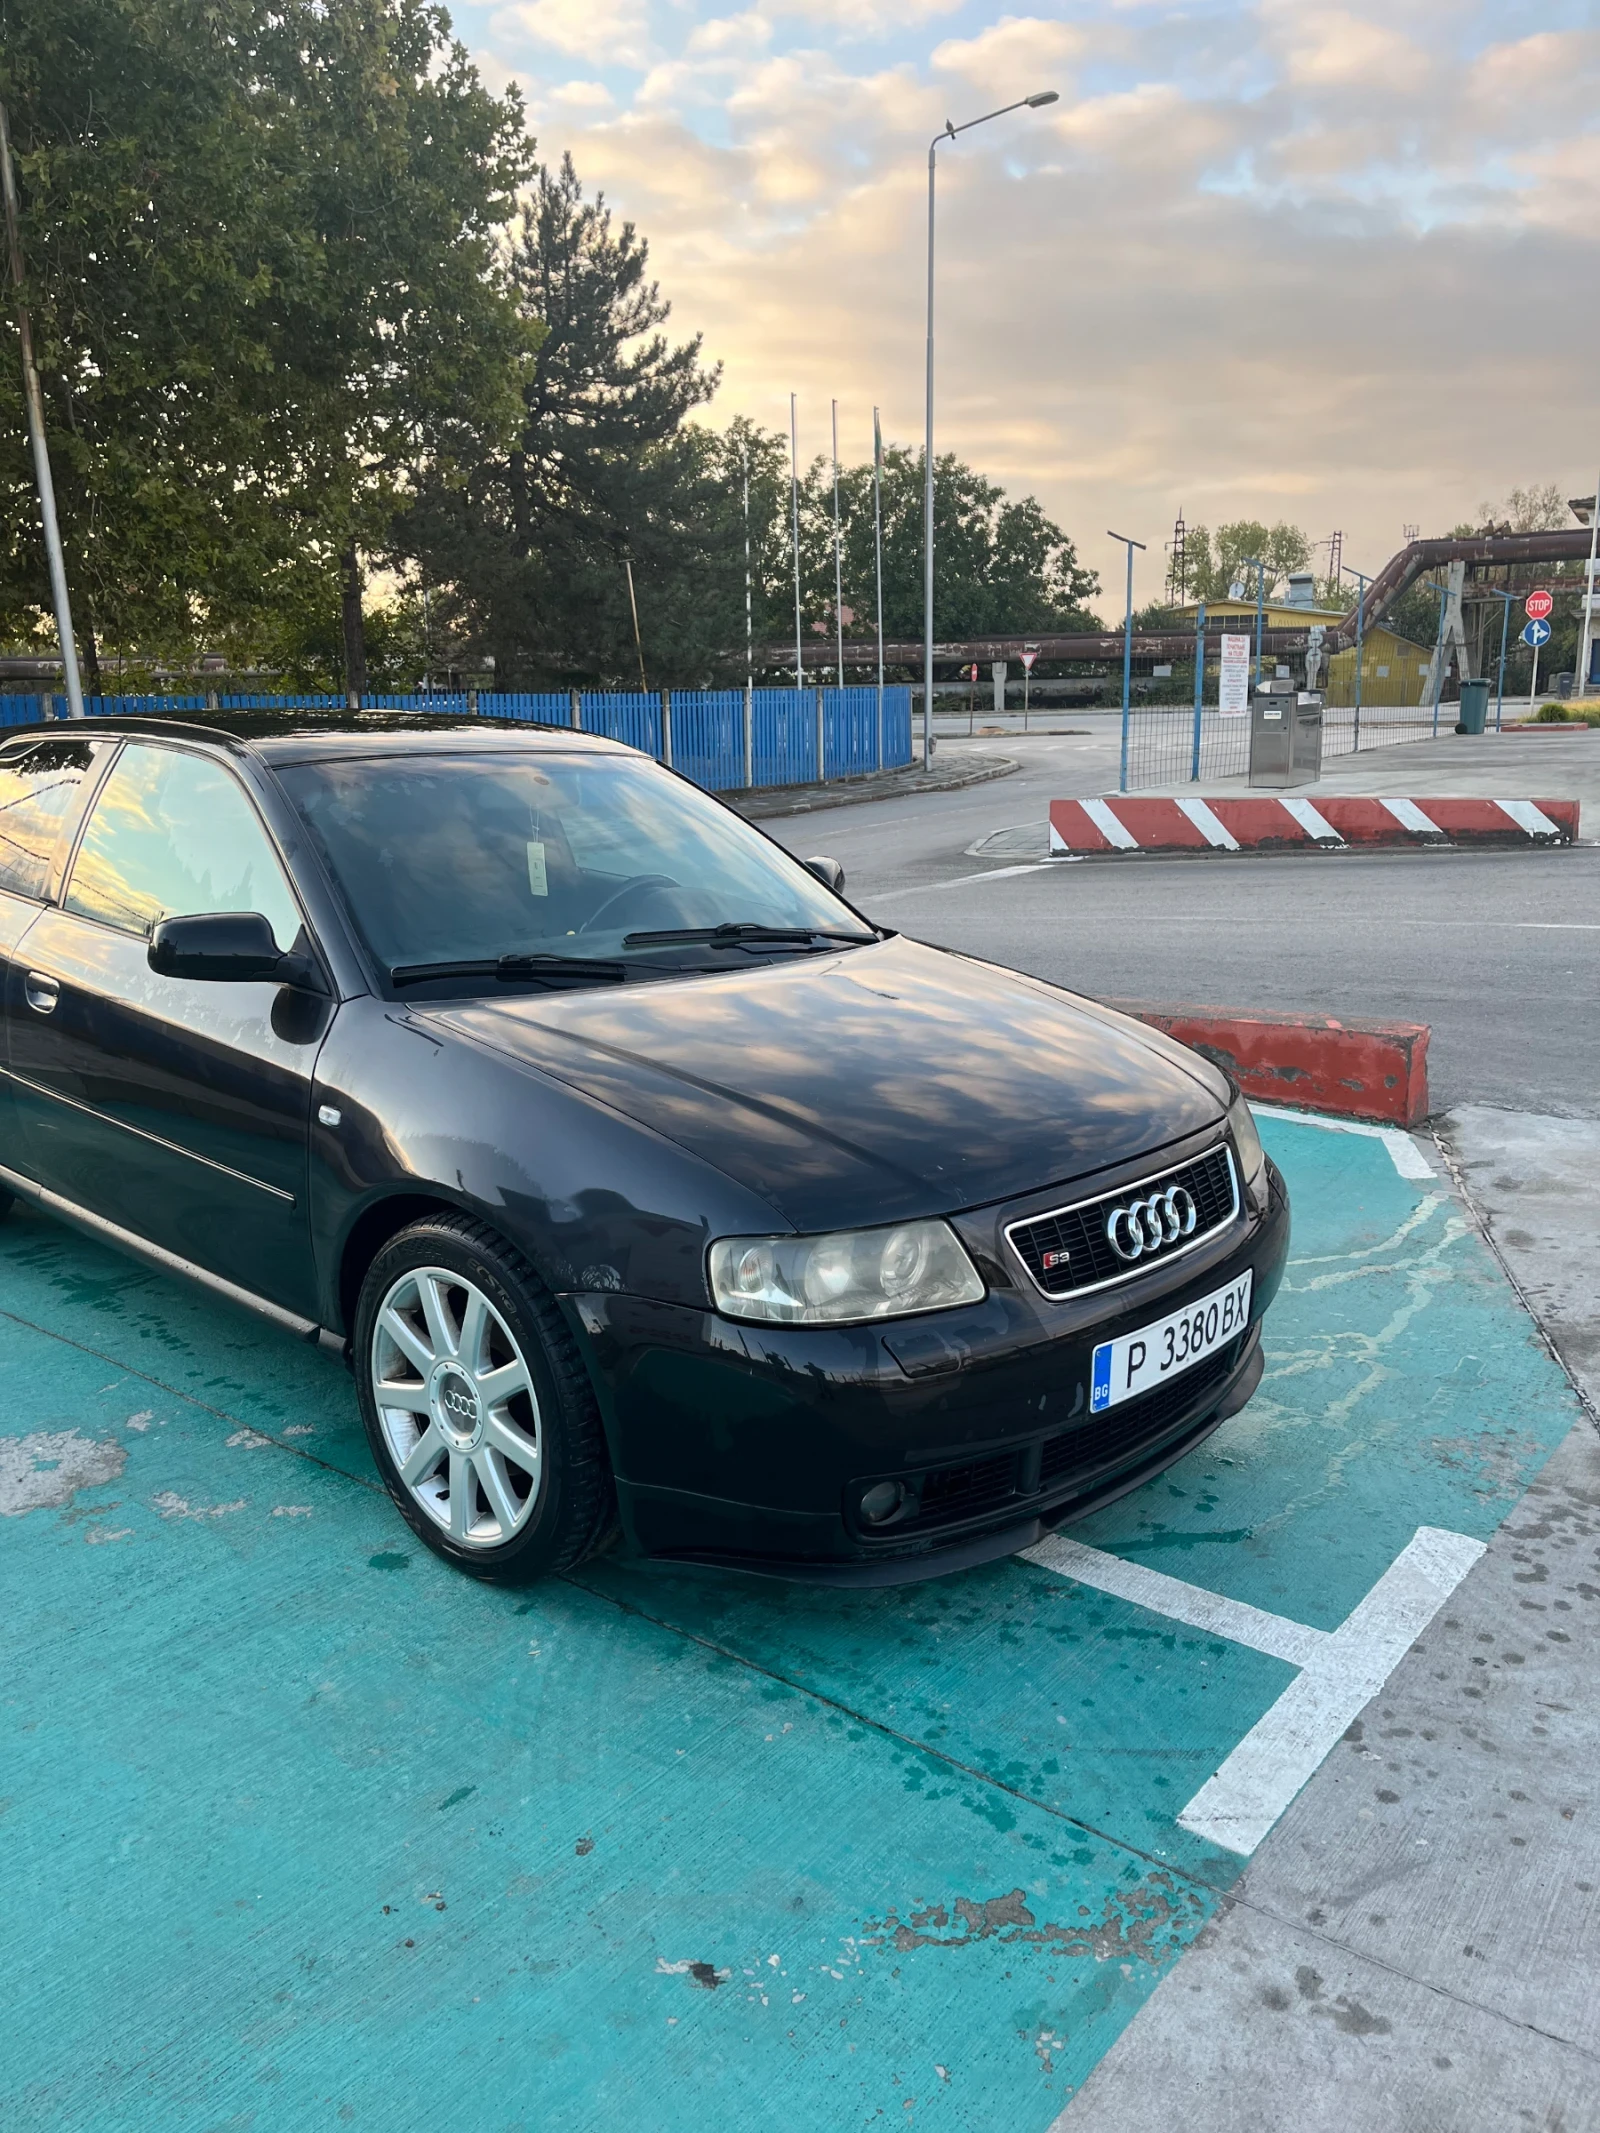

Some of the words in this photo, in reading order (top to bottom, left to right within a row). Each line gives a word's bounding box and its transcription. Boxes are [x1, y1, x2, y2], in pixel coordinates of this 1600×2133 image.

[1528, 599, 1550, 612] STOP
[1048, 1252, 1070, 1266] S3
[1126, 1341, 1147, 1389] P
[1094, 1384, 1109, 1401] BG
